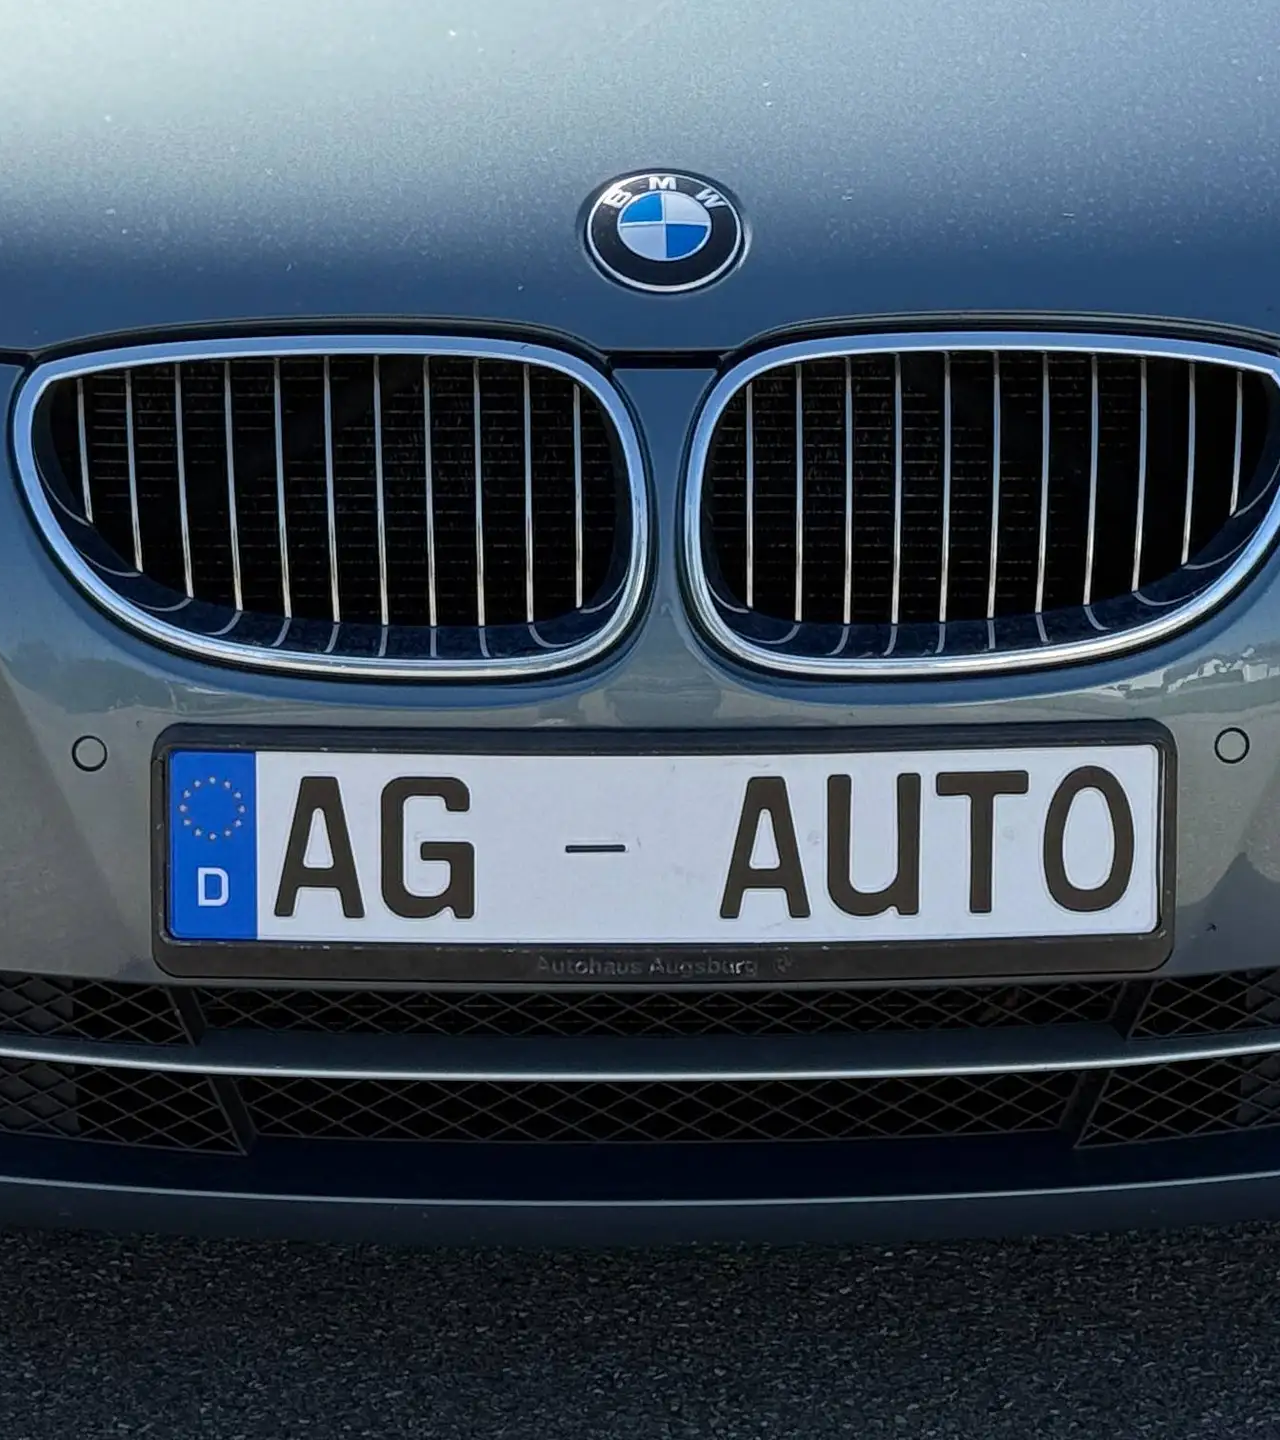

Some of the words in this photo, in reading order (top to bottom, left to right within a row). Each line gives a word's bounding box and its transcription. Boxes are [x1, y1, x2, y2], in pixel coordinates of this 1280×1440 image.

[603, 176, 727, 209] BMW
[273, 775, 475, 920] AG
[719, 764, 1135, 920] AUTO
[197, 866, 229, 907] D
[535, 955, 642, 975] Autohaus
[650, 955, 759, 979] Augsburg
